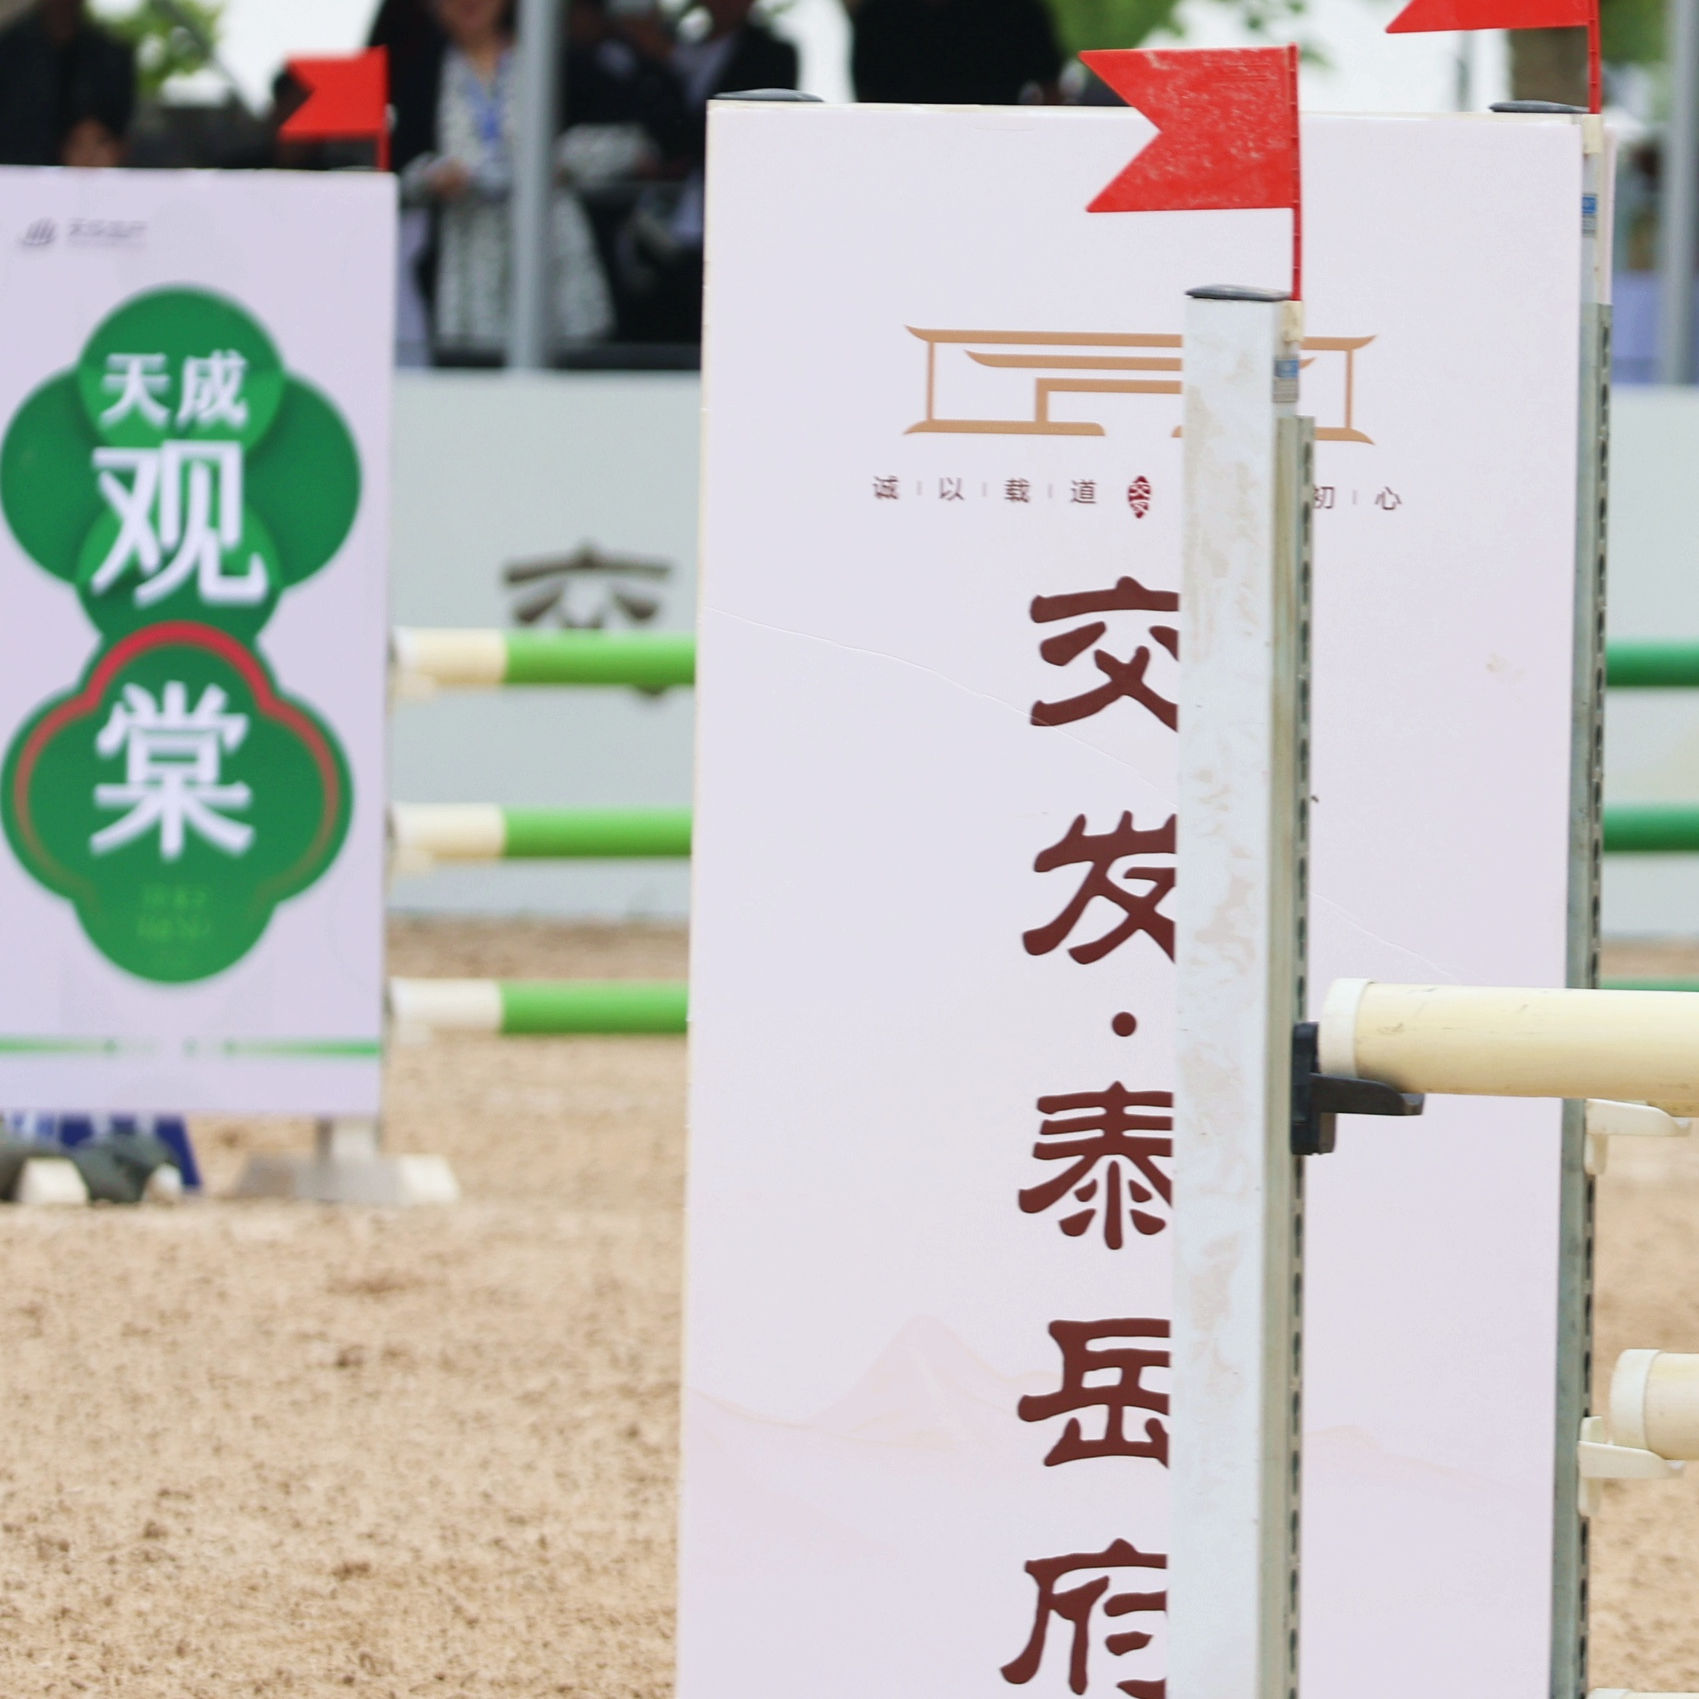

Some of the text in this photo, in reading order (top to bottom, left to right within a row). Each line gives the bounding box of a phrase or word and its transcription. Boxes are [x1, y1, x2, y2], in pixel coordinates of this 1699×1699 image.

[100, 348, 250, 430] 天成
[90, 437, 270, 607] 观
[90, 676, 256, 861] 棠
